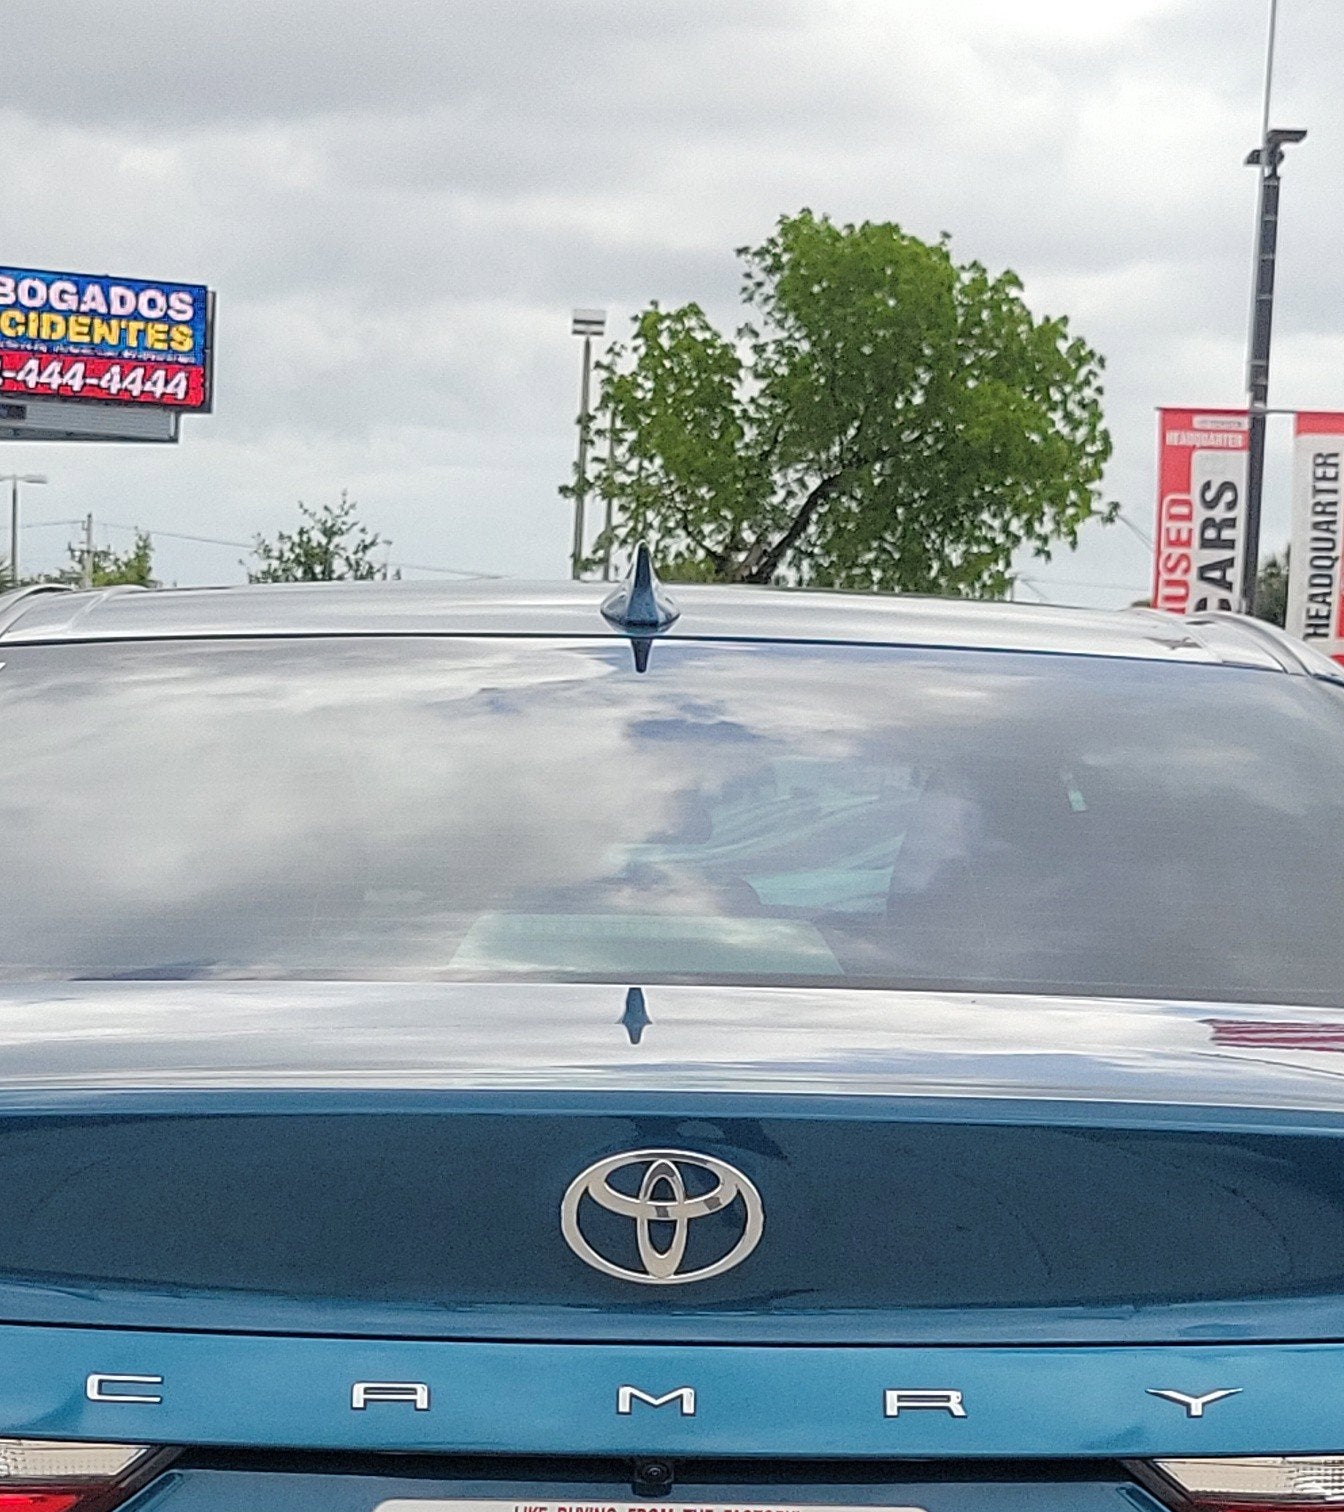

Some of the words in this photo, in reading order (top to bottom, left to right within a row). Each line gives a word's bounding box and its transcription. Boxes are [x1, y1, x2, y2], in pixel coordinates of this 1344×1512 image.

[1160, 495, 1194, 606] USED
[1304, 452, 1340, 639] HEADQUARTER
[85, 1373, 1244, 1418] CAMRY
